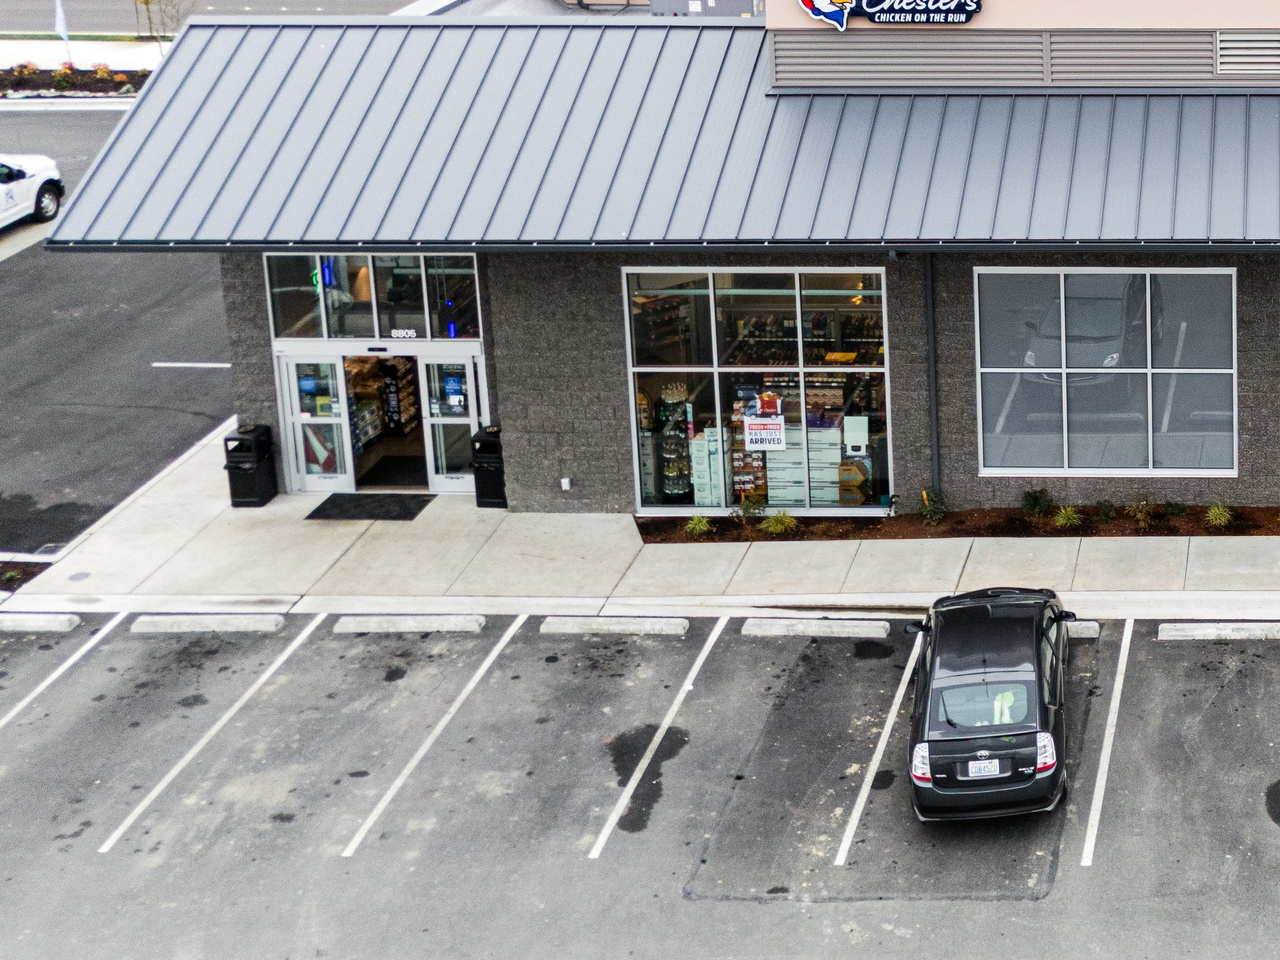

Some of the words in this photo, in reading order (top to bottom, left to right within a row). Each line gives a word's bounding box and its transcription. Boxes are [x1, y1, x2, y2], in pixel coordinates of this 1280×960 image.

[875, 13, 912, 22] CHICKEN
[914, 13, 928, 22] ON
[929, 13, 945, 22] THE
[947, 13, 966, 22] RUN
[391, 329, 417, 338] 8805
[749, 437, 782, 445] ARRIVED
